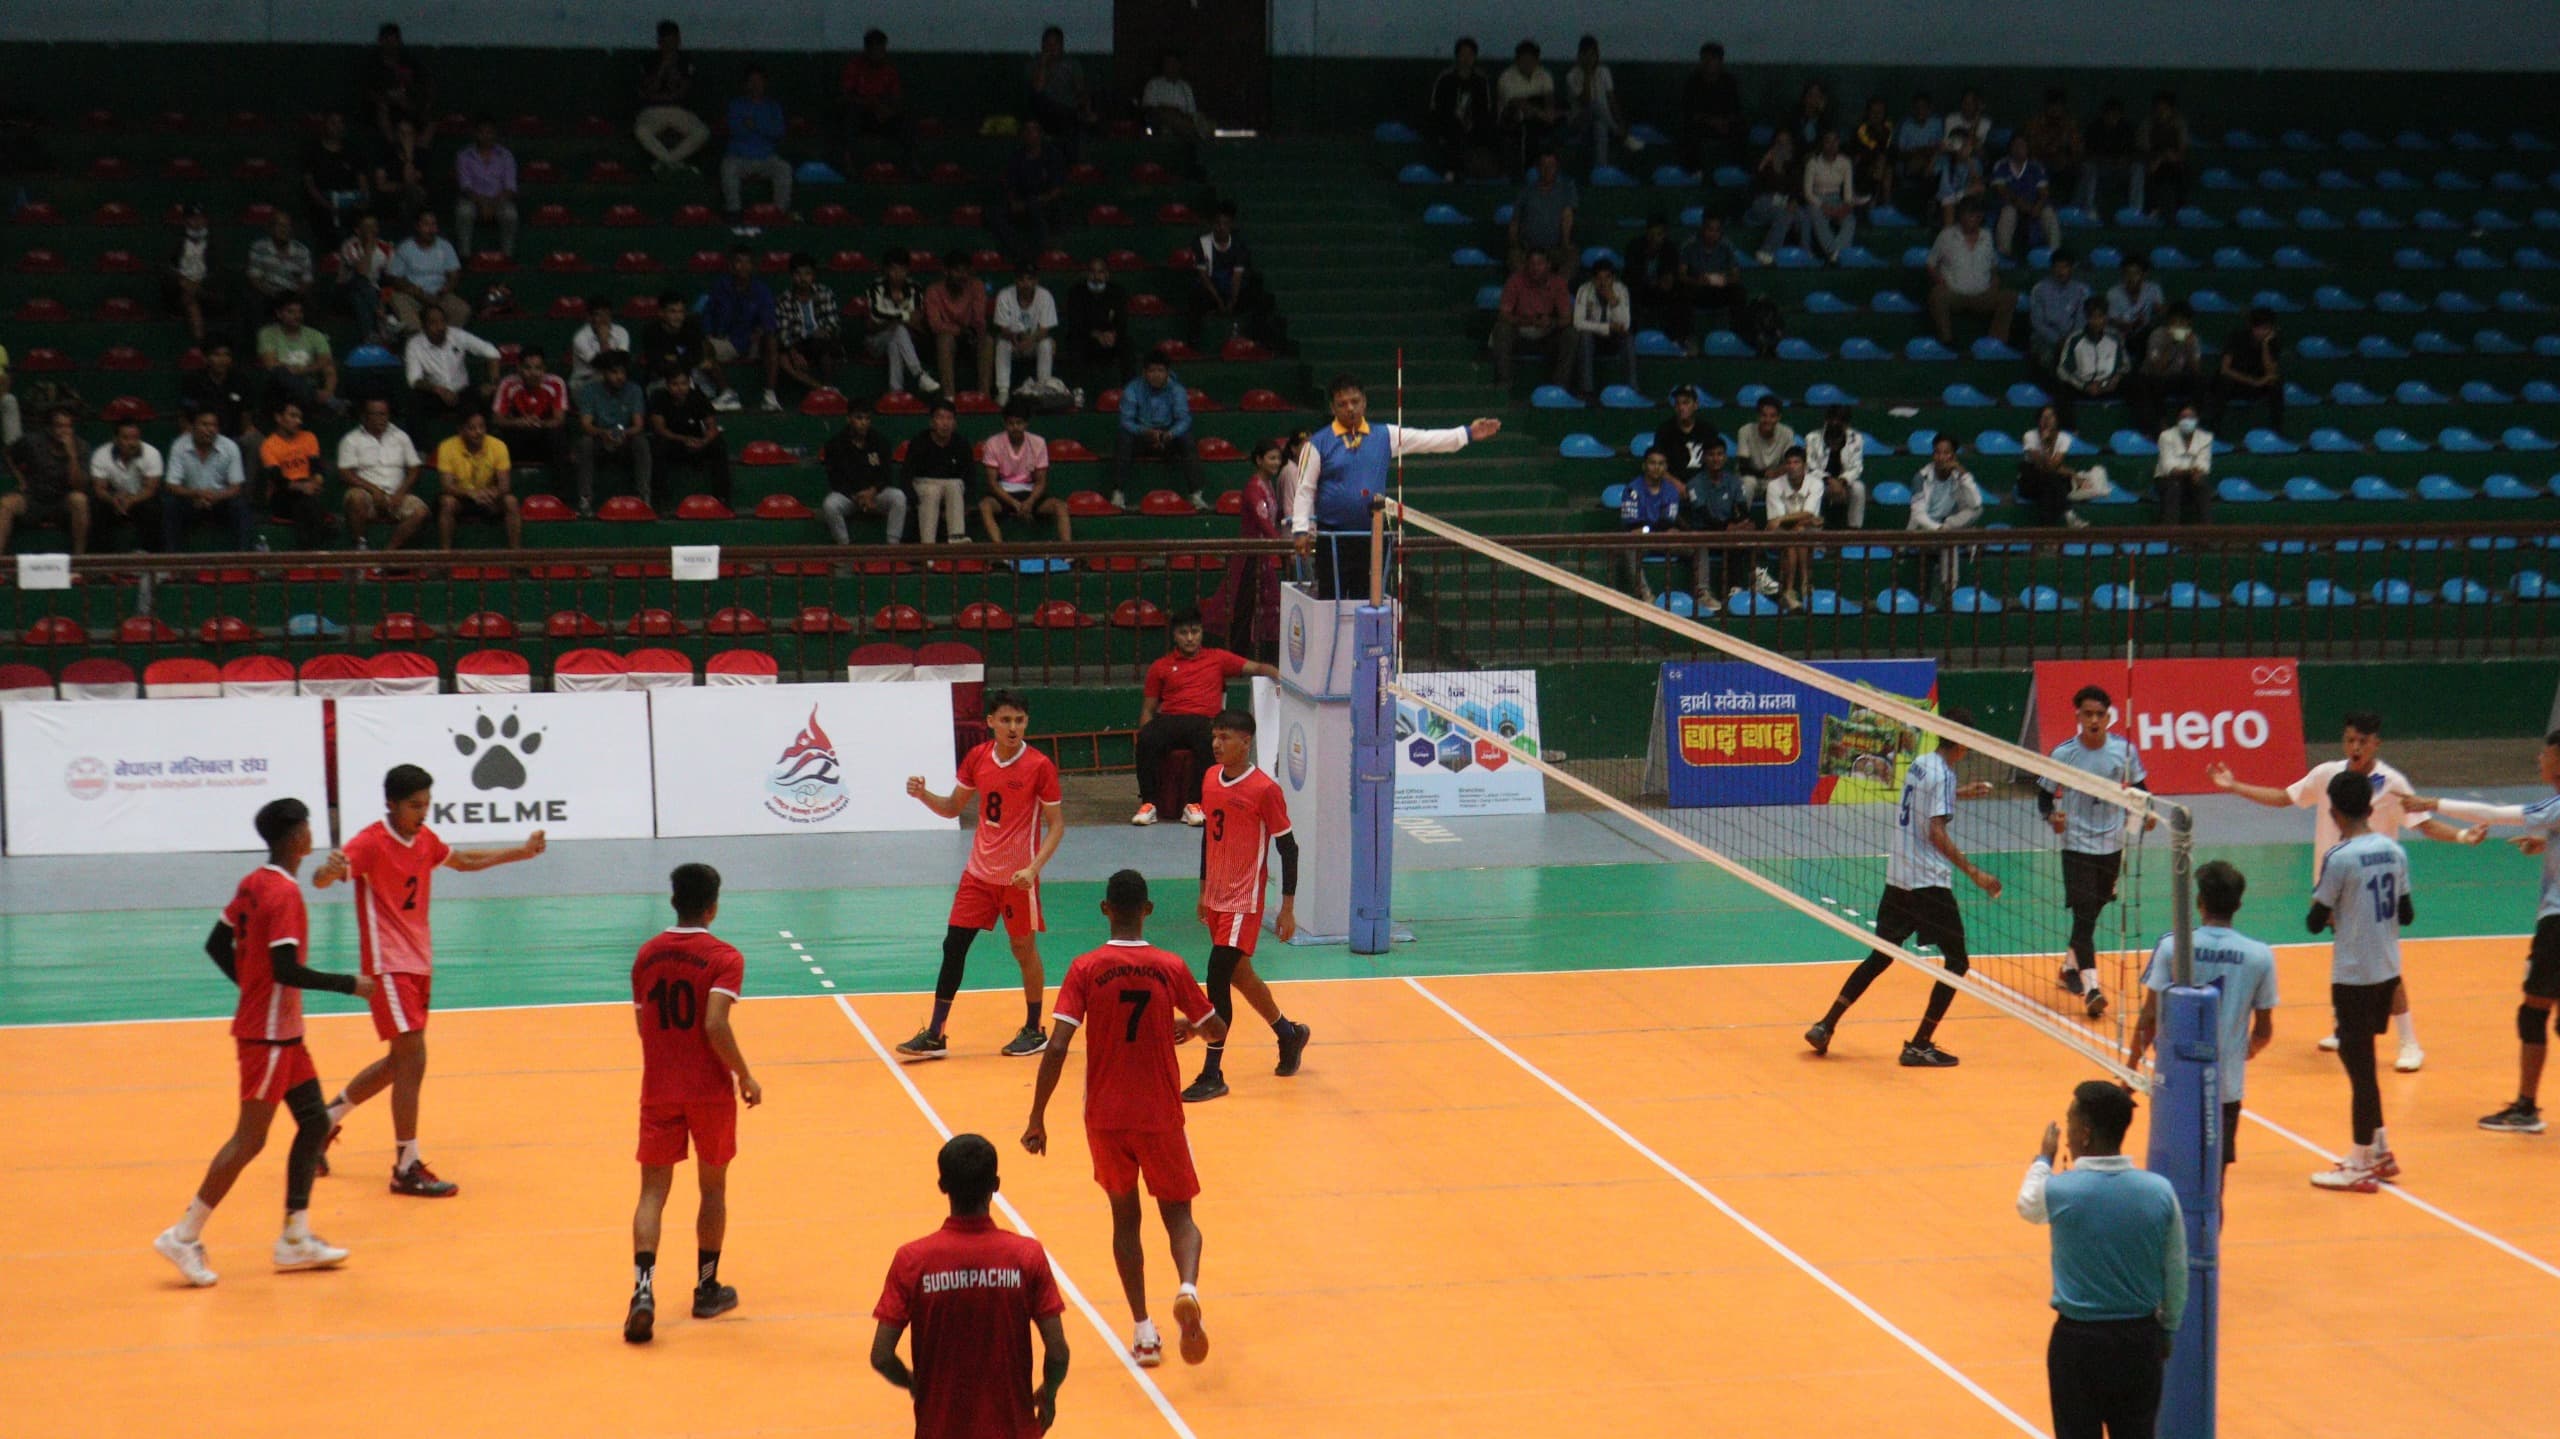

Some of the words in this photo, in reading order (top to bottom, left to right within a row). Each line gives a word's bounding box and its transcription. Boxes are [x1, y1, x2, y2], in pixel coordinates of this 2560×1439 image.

[1680, 691, 1711, 713] हामी
[1759, 693, 1796, 709] मनमा
[2137, 709, 2269, 750] Hero
[115, 760, 163, 776] नेपाल
[433, 800, 567, 824] KELME
[985, 791, 1002, 822] 8
[1213, 809, 1225, 841] 3
[402, 875, 417, 910] 2
[2366, 872, 2395, 922] 13
[1005, 904, 1014, 919] 8
[647, 977, 697, 1031] 10
[1120, 989, 1152, 1043] 7
[922, 1267, 1021, 1294] SUDURPACHIM
